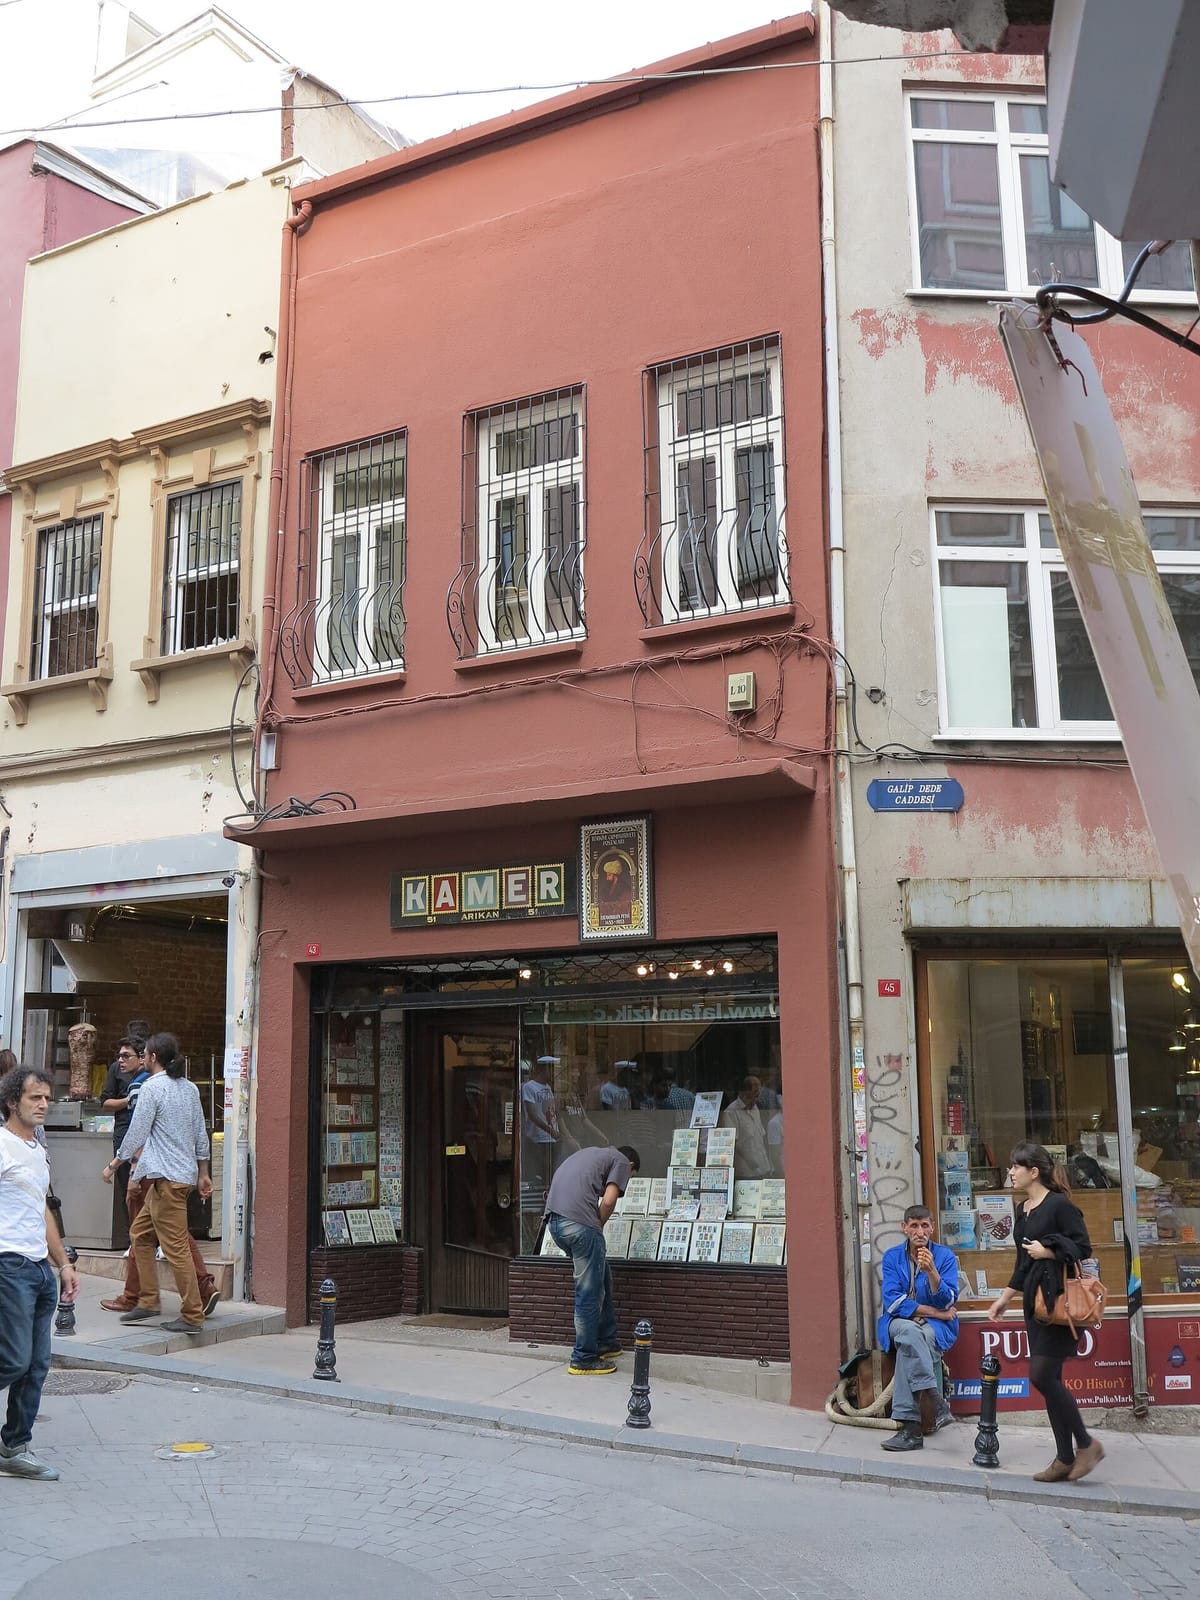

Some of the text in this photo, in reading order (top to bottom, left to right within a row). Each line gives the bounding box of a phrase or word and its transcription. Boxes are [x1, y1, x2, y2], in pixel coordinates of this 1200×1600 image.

[887, 784, 942, 793] GALİP DEDE
[895, 795, 935, 804] CADDESİ
[406, 871, 559, 911] KAMER
[461, 910, 500, 921] ARIKAN
[884, 983, 895, 993] 45
